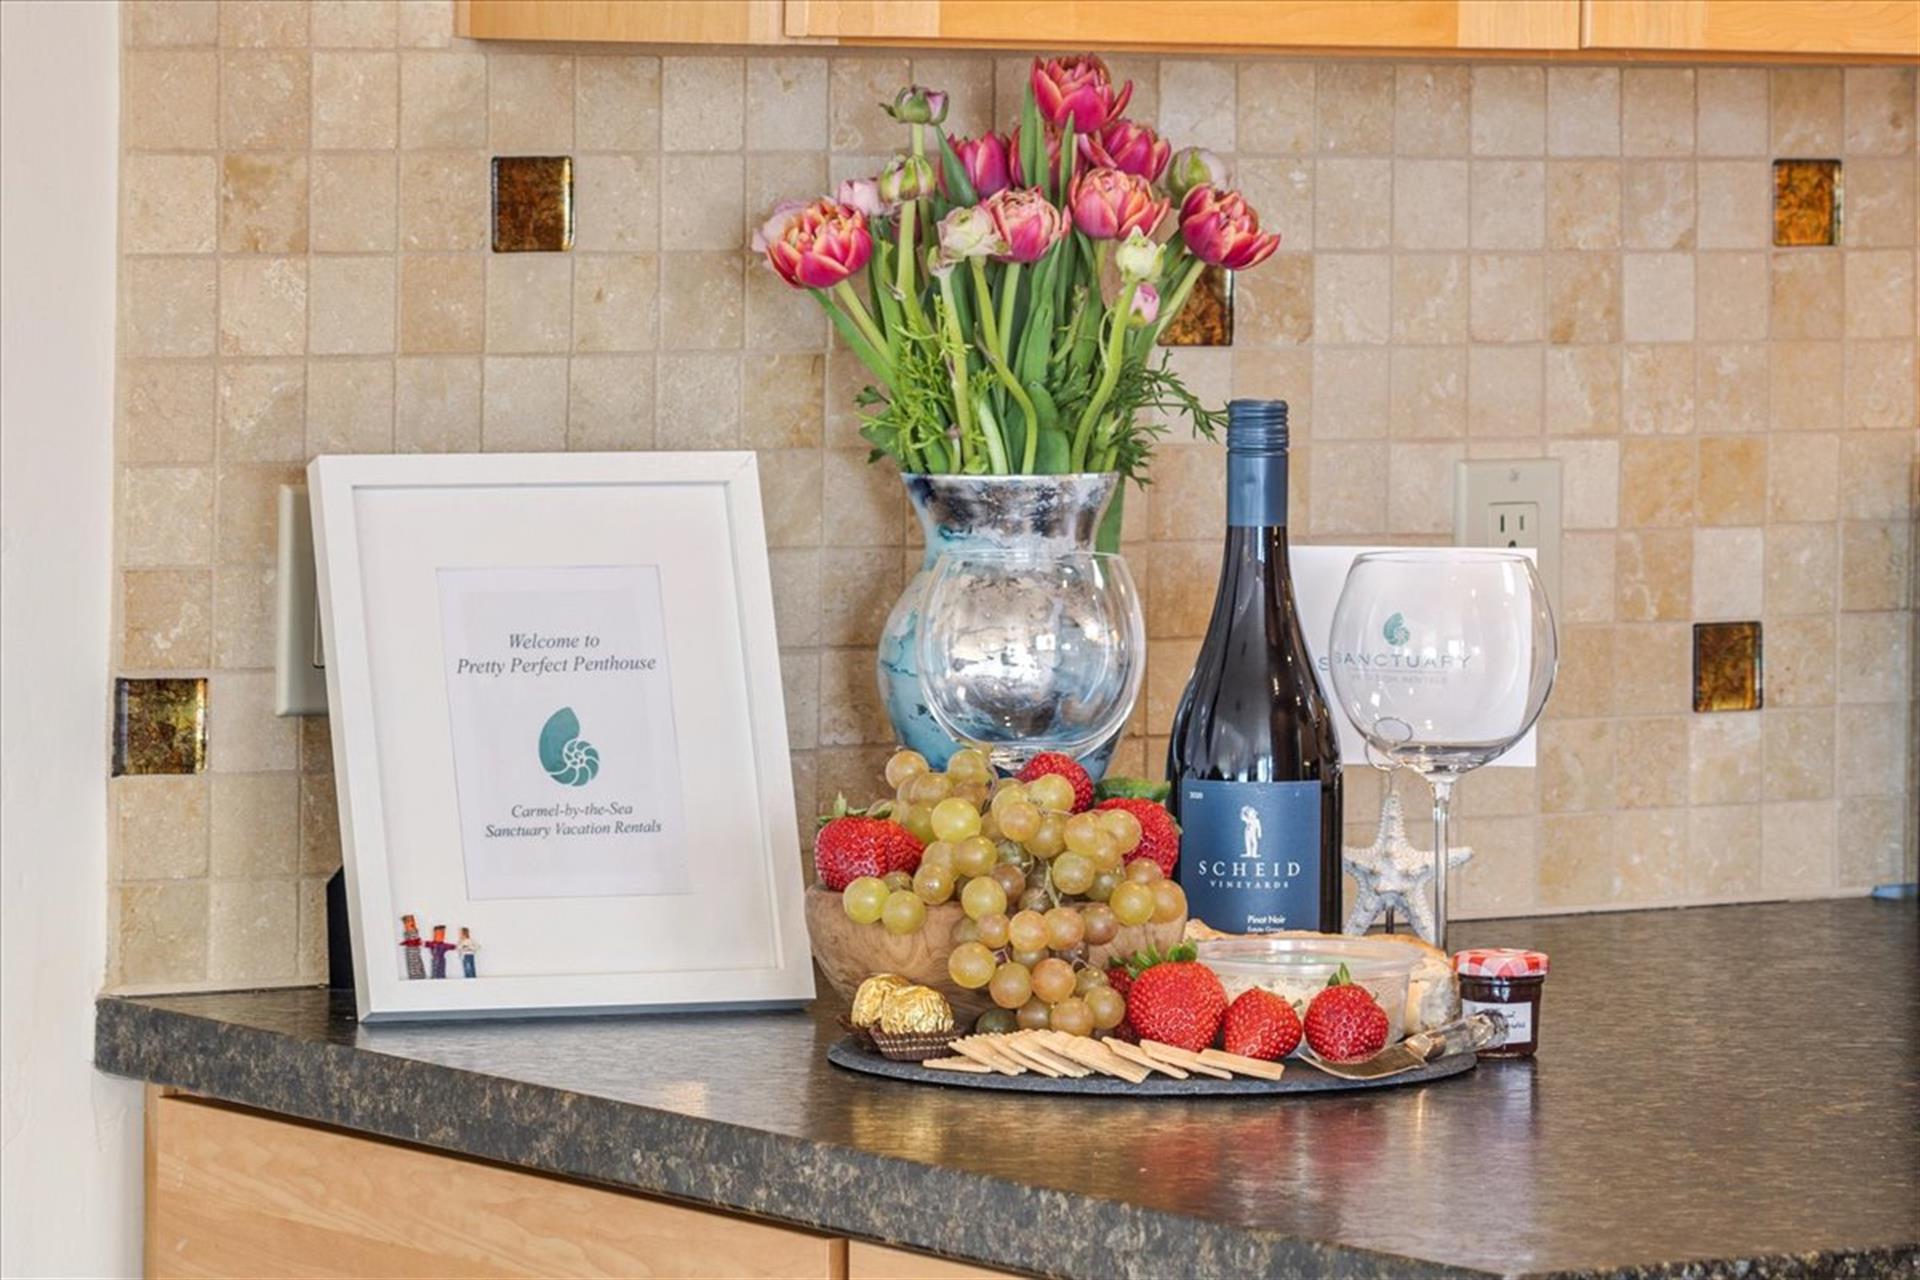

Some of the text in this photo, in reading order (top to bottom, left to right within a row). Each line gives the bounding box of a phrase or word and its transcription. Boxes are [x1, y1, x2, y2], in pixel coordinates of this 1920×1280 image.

[508, 633, 600, 650] Welcome to
[456, 655, 657, 677] Pretty Perfect Penthouse
[511, 802, 634, 820] Carmel-by-the-Sea
[485, 819, 662, 840] Sanctuary Vacation Rentals
[1198, 860, 1301, 877] SCHEID
[1210, 880, 1290, 889] VINEYARDS
[1247, 914, 1267, 924] Pinot
